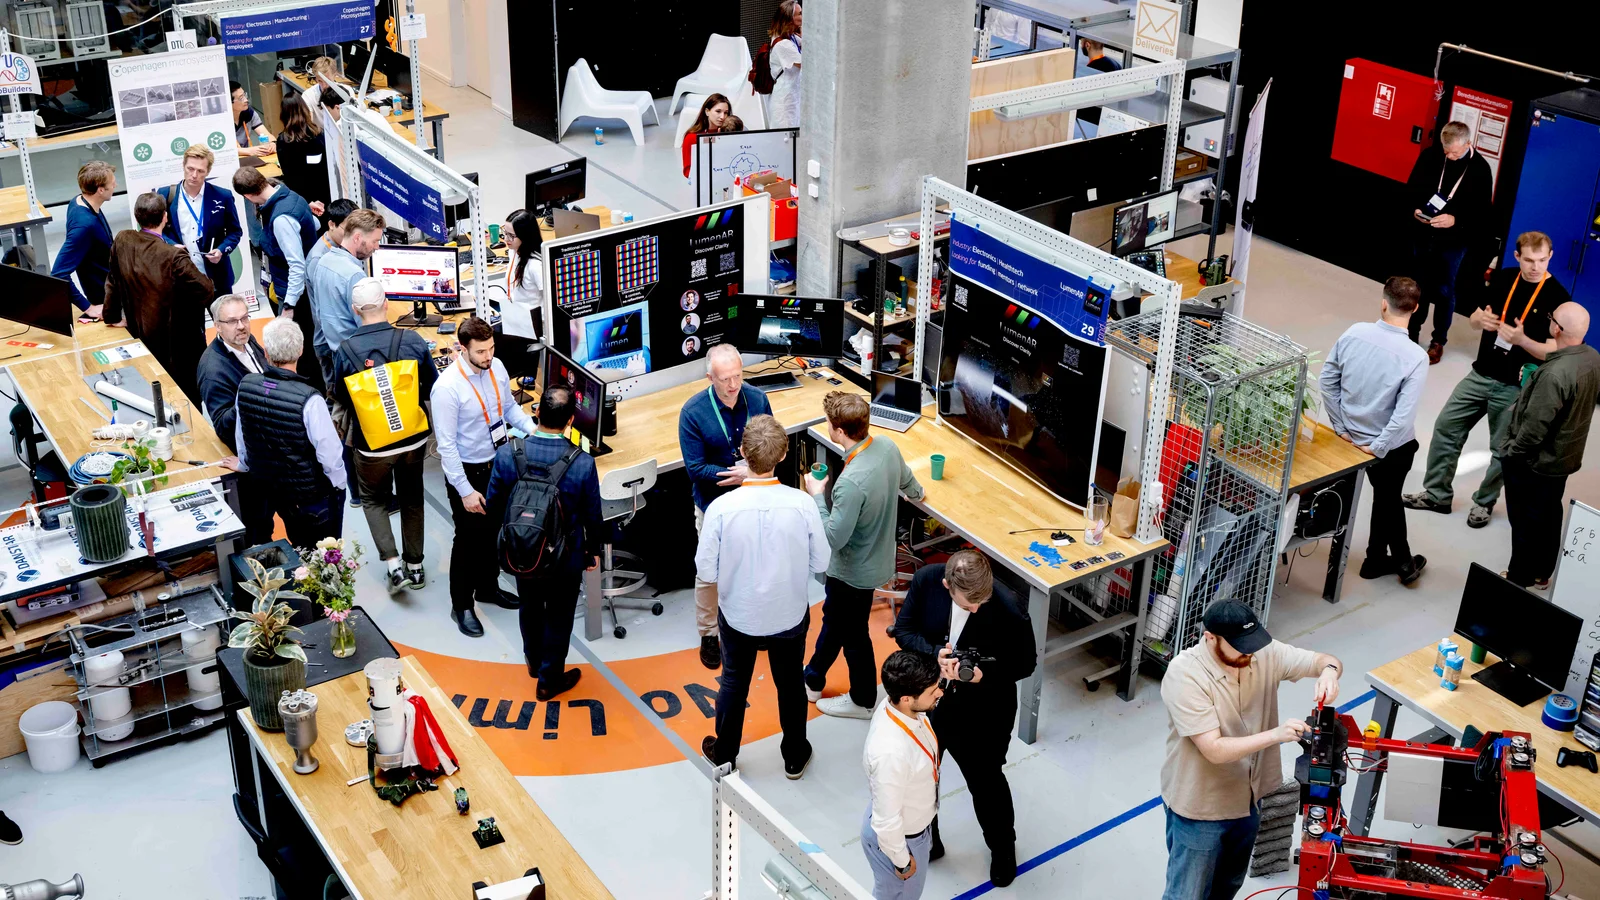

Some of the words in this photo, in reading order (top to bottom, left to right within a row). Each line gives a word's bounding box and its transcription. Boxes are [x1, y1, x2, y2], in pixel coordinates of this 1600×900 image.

[340, 11, 371, 20] Microsystems
[342, 5, 371, 14] Copenhagen
[246, 19, 272, 28] Electronics
[274, 14, 308, 25] Manufacturing
[275, 30, 301, 39] co-founder
[360, 25, 370, 34] 27
[170, 40, 185, 50] DTU
[226, 43, 254, 51] employees
[1135, 37, 1174, 57] Deliveries
[168, 53, 225, 66] microsystems
[1456, 90, 1509, 110] Beredskabsinformation
[432, 222, 441, 234] 28
[690, 229, 734, 247] LumenAR
[561, 245, 581, 253] Traditional
[694, 246, 715, 255] Discover
[952, 239, 972, 252] Industry:
[972, 245, 997, 263] Electronics
[998, 259, 1024, 277] Healthtech
[951, 251, 969, 265] Looking
[968, 257, 977, 265] for
[977, 260, 996, 275] funding
[997, 271, 1015, 286] mentors
[1017, 282, 1039, 297] network
[1060, 281, 1084, 300] LumenAR
[572, 304, 592, 312] reflections
[999, 321, 1038, 349] LumenAR
[1081, 322, 1095, 337] 29
[600, 337, 629, 348] Lumen
[1002, 336, 1020, 350] Discover
[1019, 344, 1032, 357] Clarity
[380, 387, 403, 431] GRÜNBAG
[2, 534, 30, 570] DANSTAR
